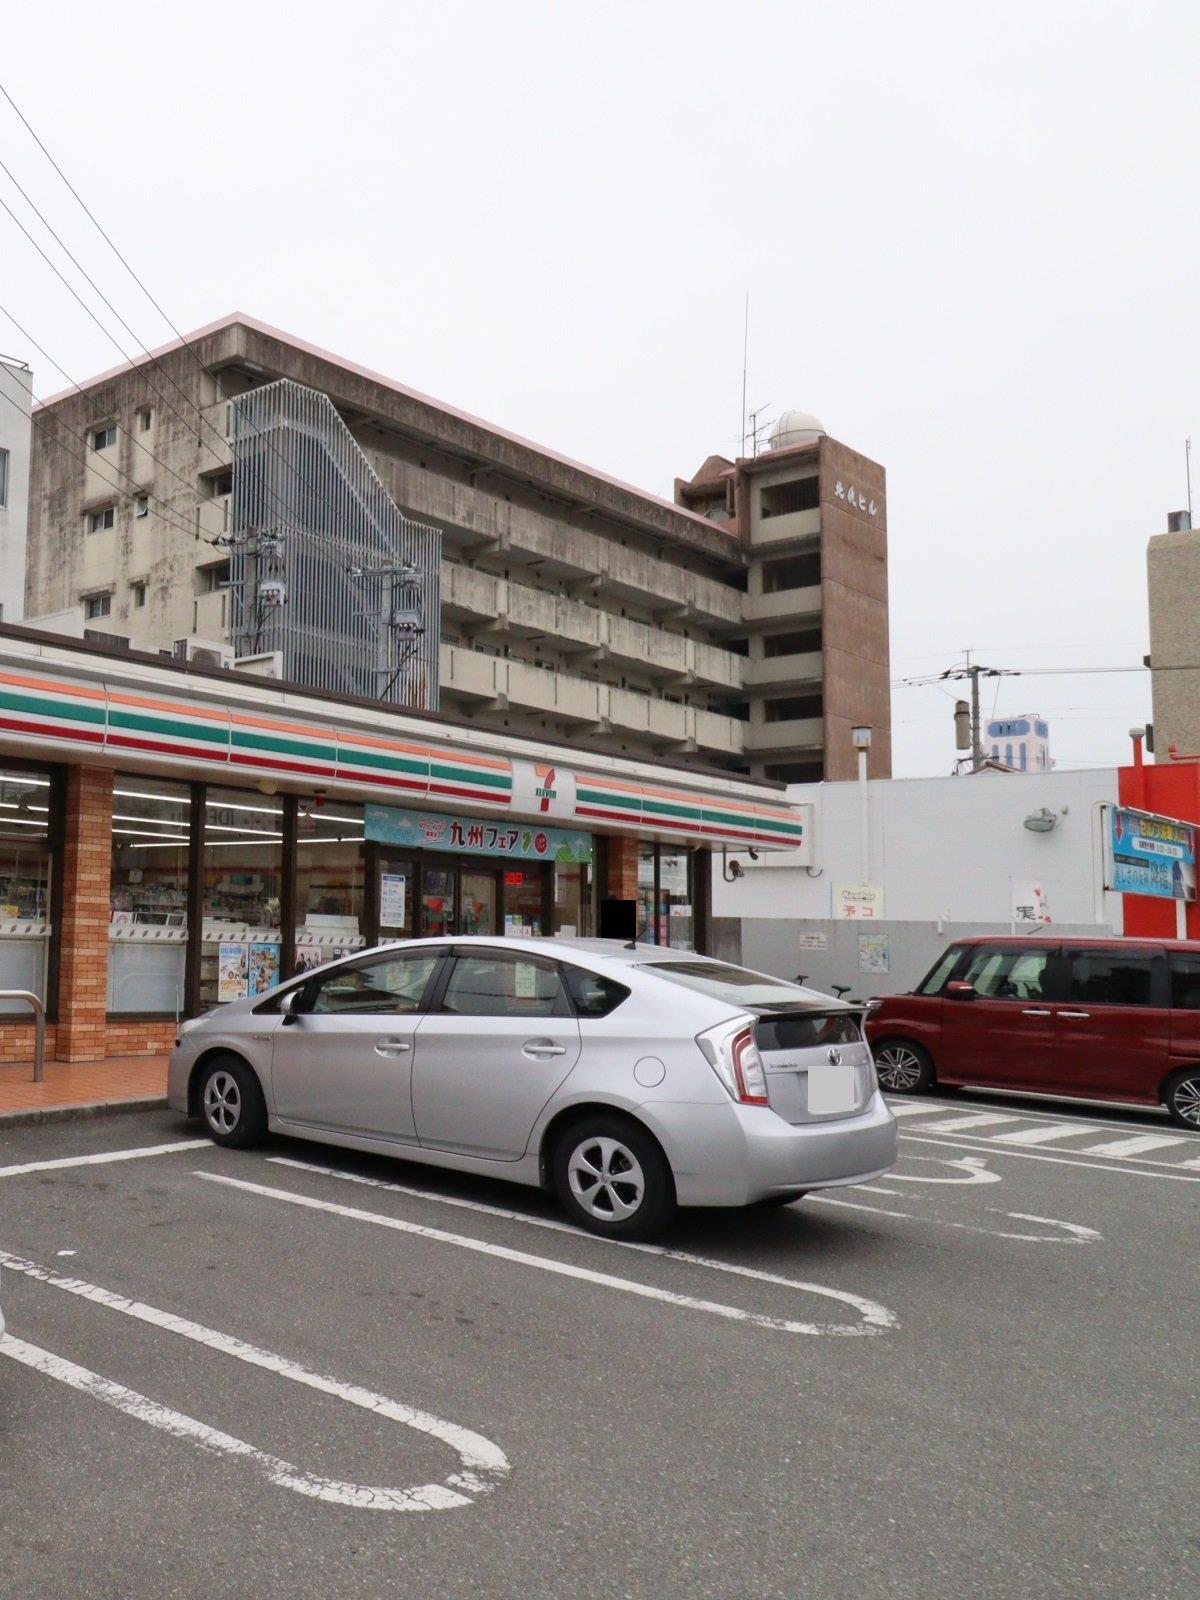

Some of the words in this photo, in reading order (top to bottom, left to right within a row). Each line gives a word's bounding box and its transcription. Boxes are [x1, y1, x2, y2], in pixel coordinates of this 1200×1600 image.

[450, 821, 519, 850] 九州フェア
